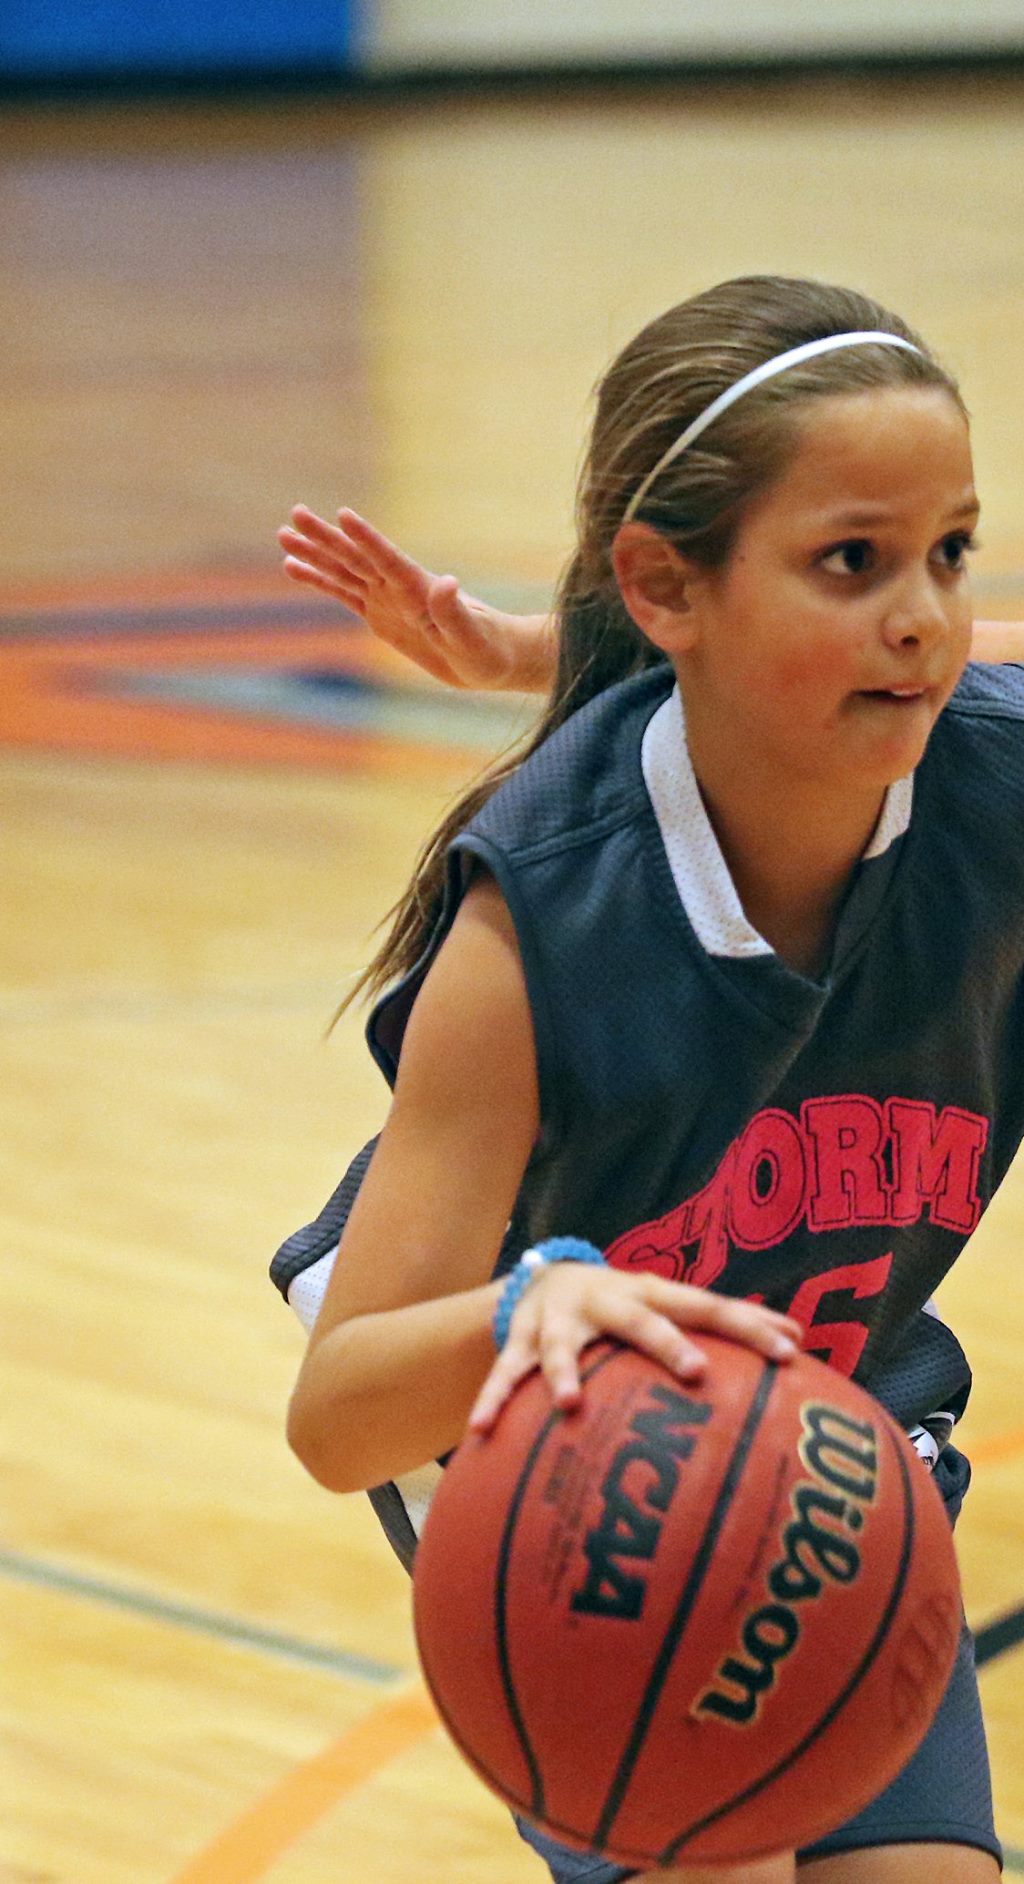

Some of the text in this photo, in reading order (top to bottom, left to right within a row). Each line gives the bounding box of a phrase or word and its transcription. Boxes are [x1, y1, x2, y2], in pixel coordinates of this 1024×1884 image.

[603, 1093, 989, 1288] STORM
[570, 1384, 713, 1622] NCAA
[692, 1402, 879, 1727] Wilson
